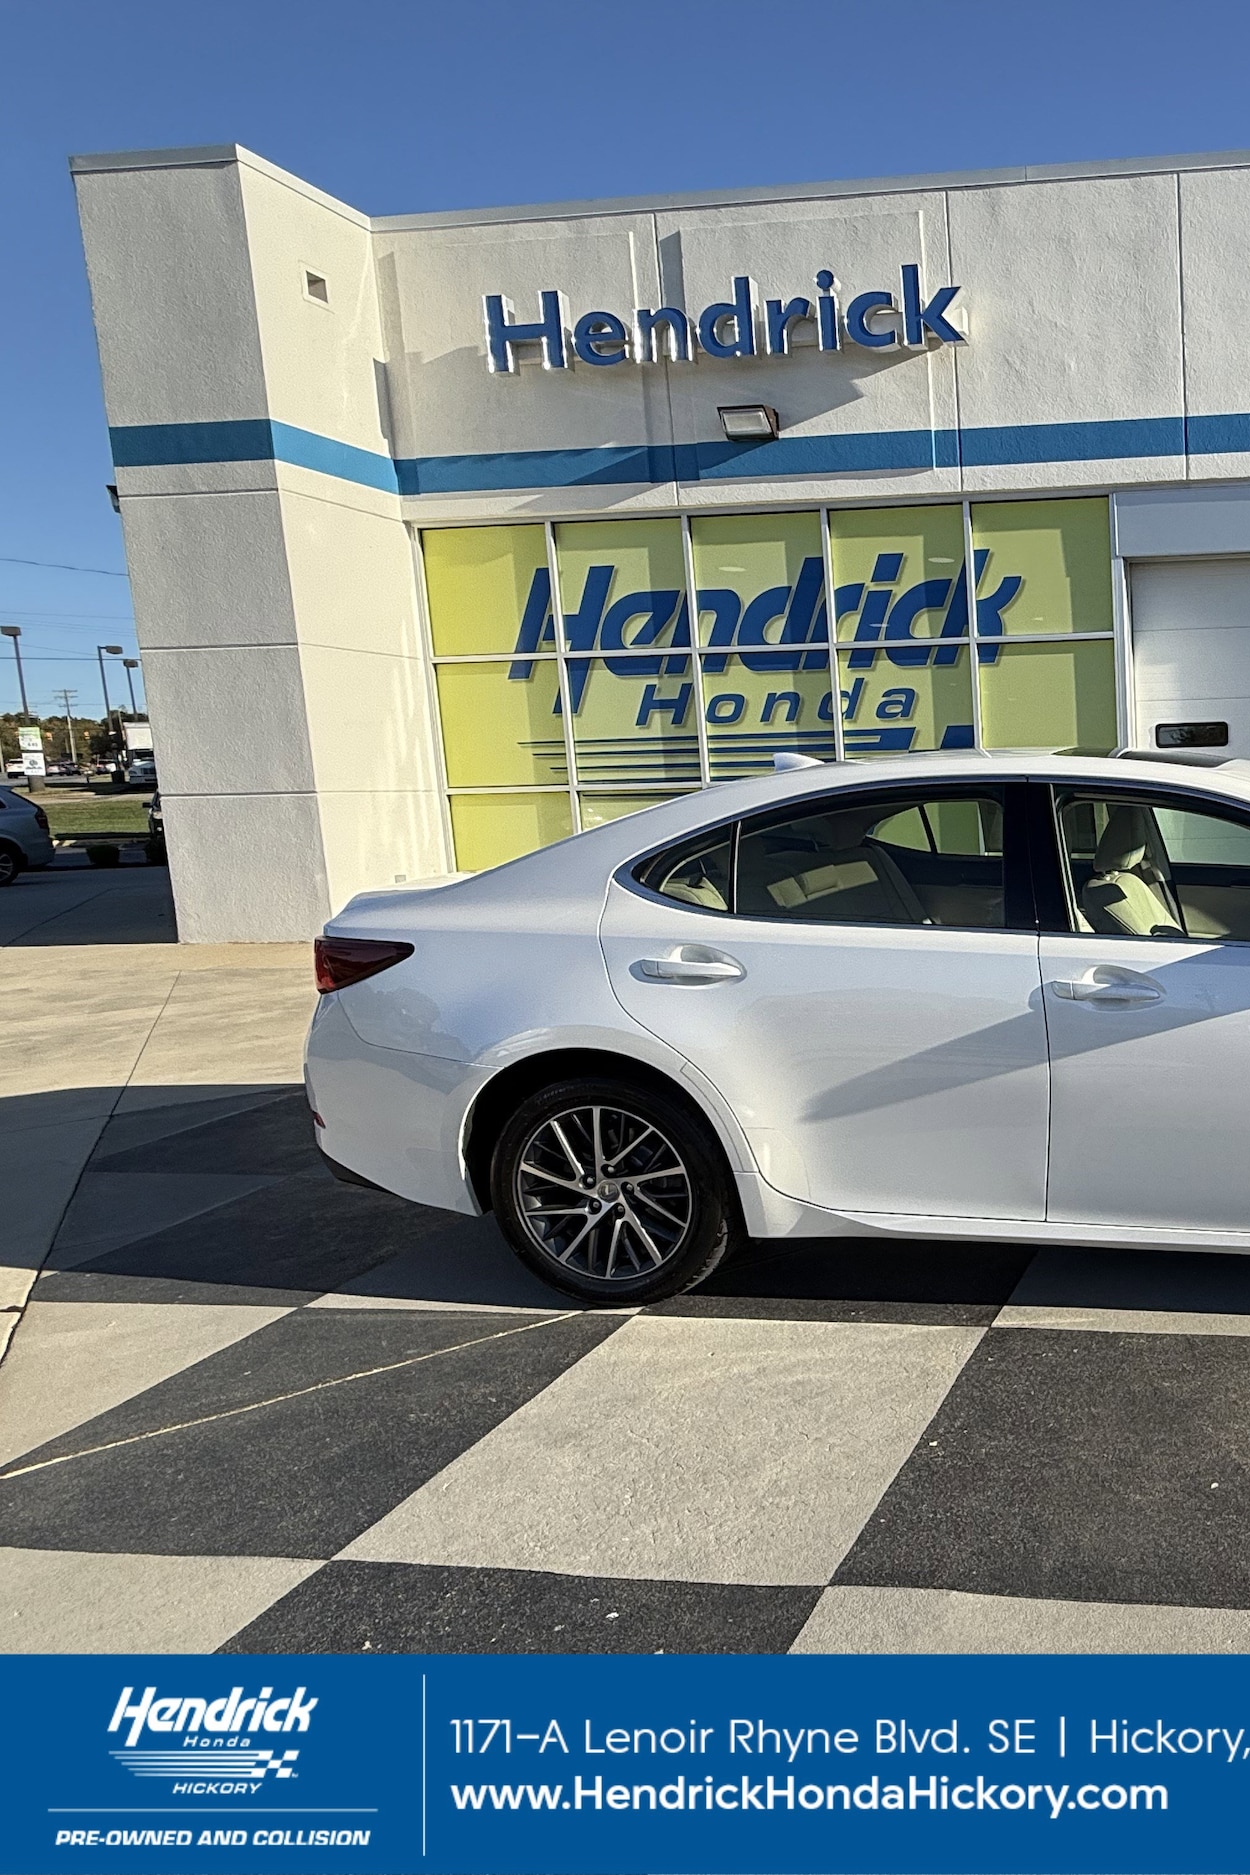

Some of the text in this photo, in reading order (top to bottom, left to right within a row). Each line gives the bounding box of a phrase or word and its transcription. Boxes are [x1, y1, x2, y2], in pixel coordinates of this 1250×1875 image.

[482, 264, 967, 375] Hendrick
[508, 548, 1022, 715] Hendrick
[636, 677, 917, 727] Honda
